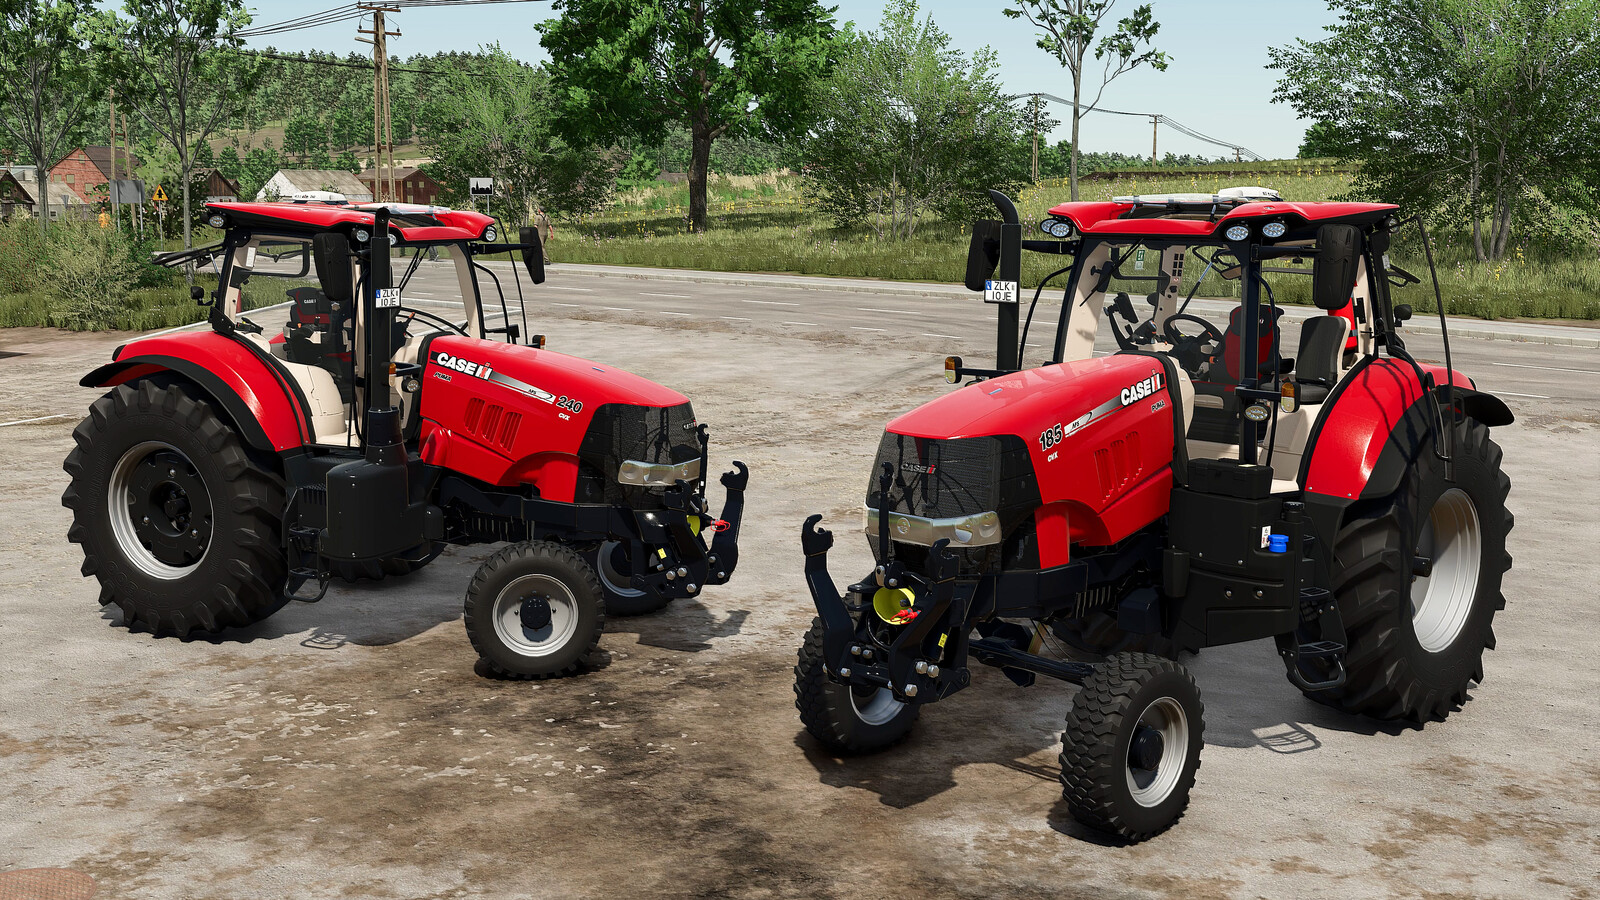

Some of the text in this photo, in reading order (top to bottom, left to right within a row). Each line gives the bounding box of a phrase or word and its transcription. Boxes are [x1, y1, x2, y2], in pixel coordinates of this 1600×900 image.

[382, 289, 395, 298] ZLK
[994, 281, 1010, 291] ZLK
[436, 352, 478, 376] CASE
[1120, 378, 1152, 406] CASE
[556, 395, 584, 414] 240
[1039, 422, 1063, 452] 185
[901, 463, 927, 473] CASE
